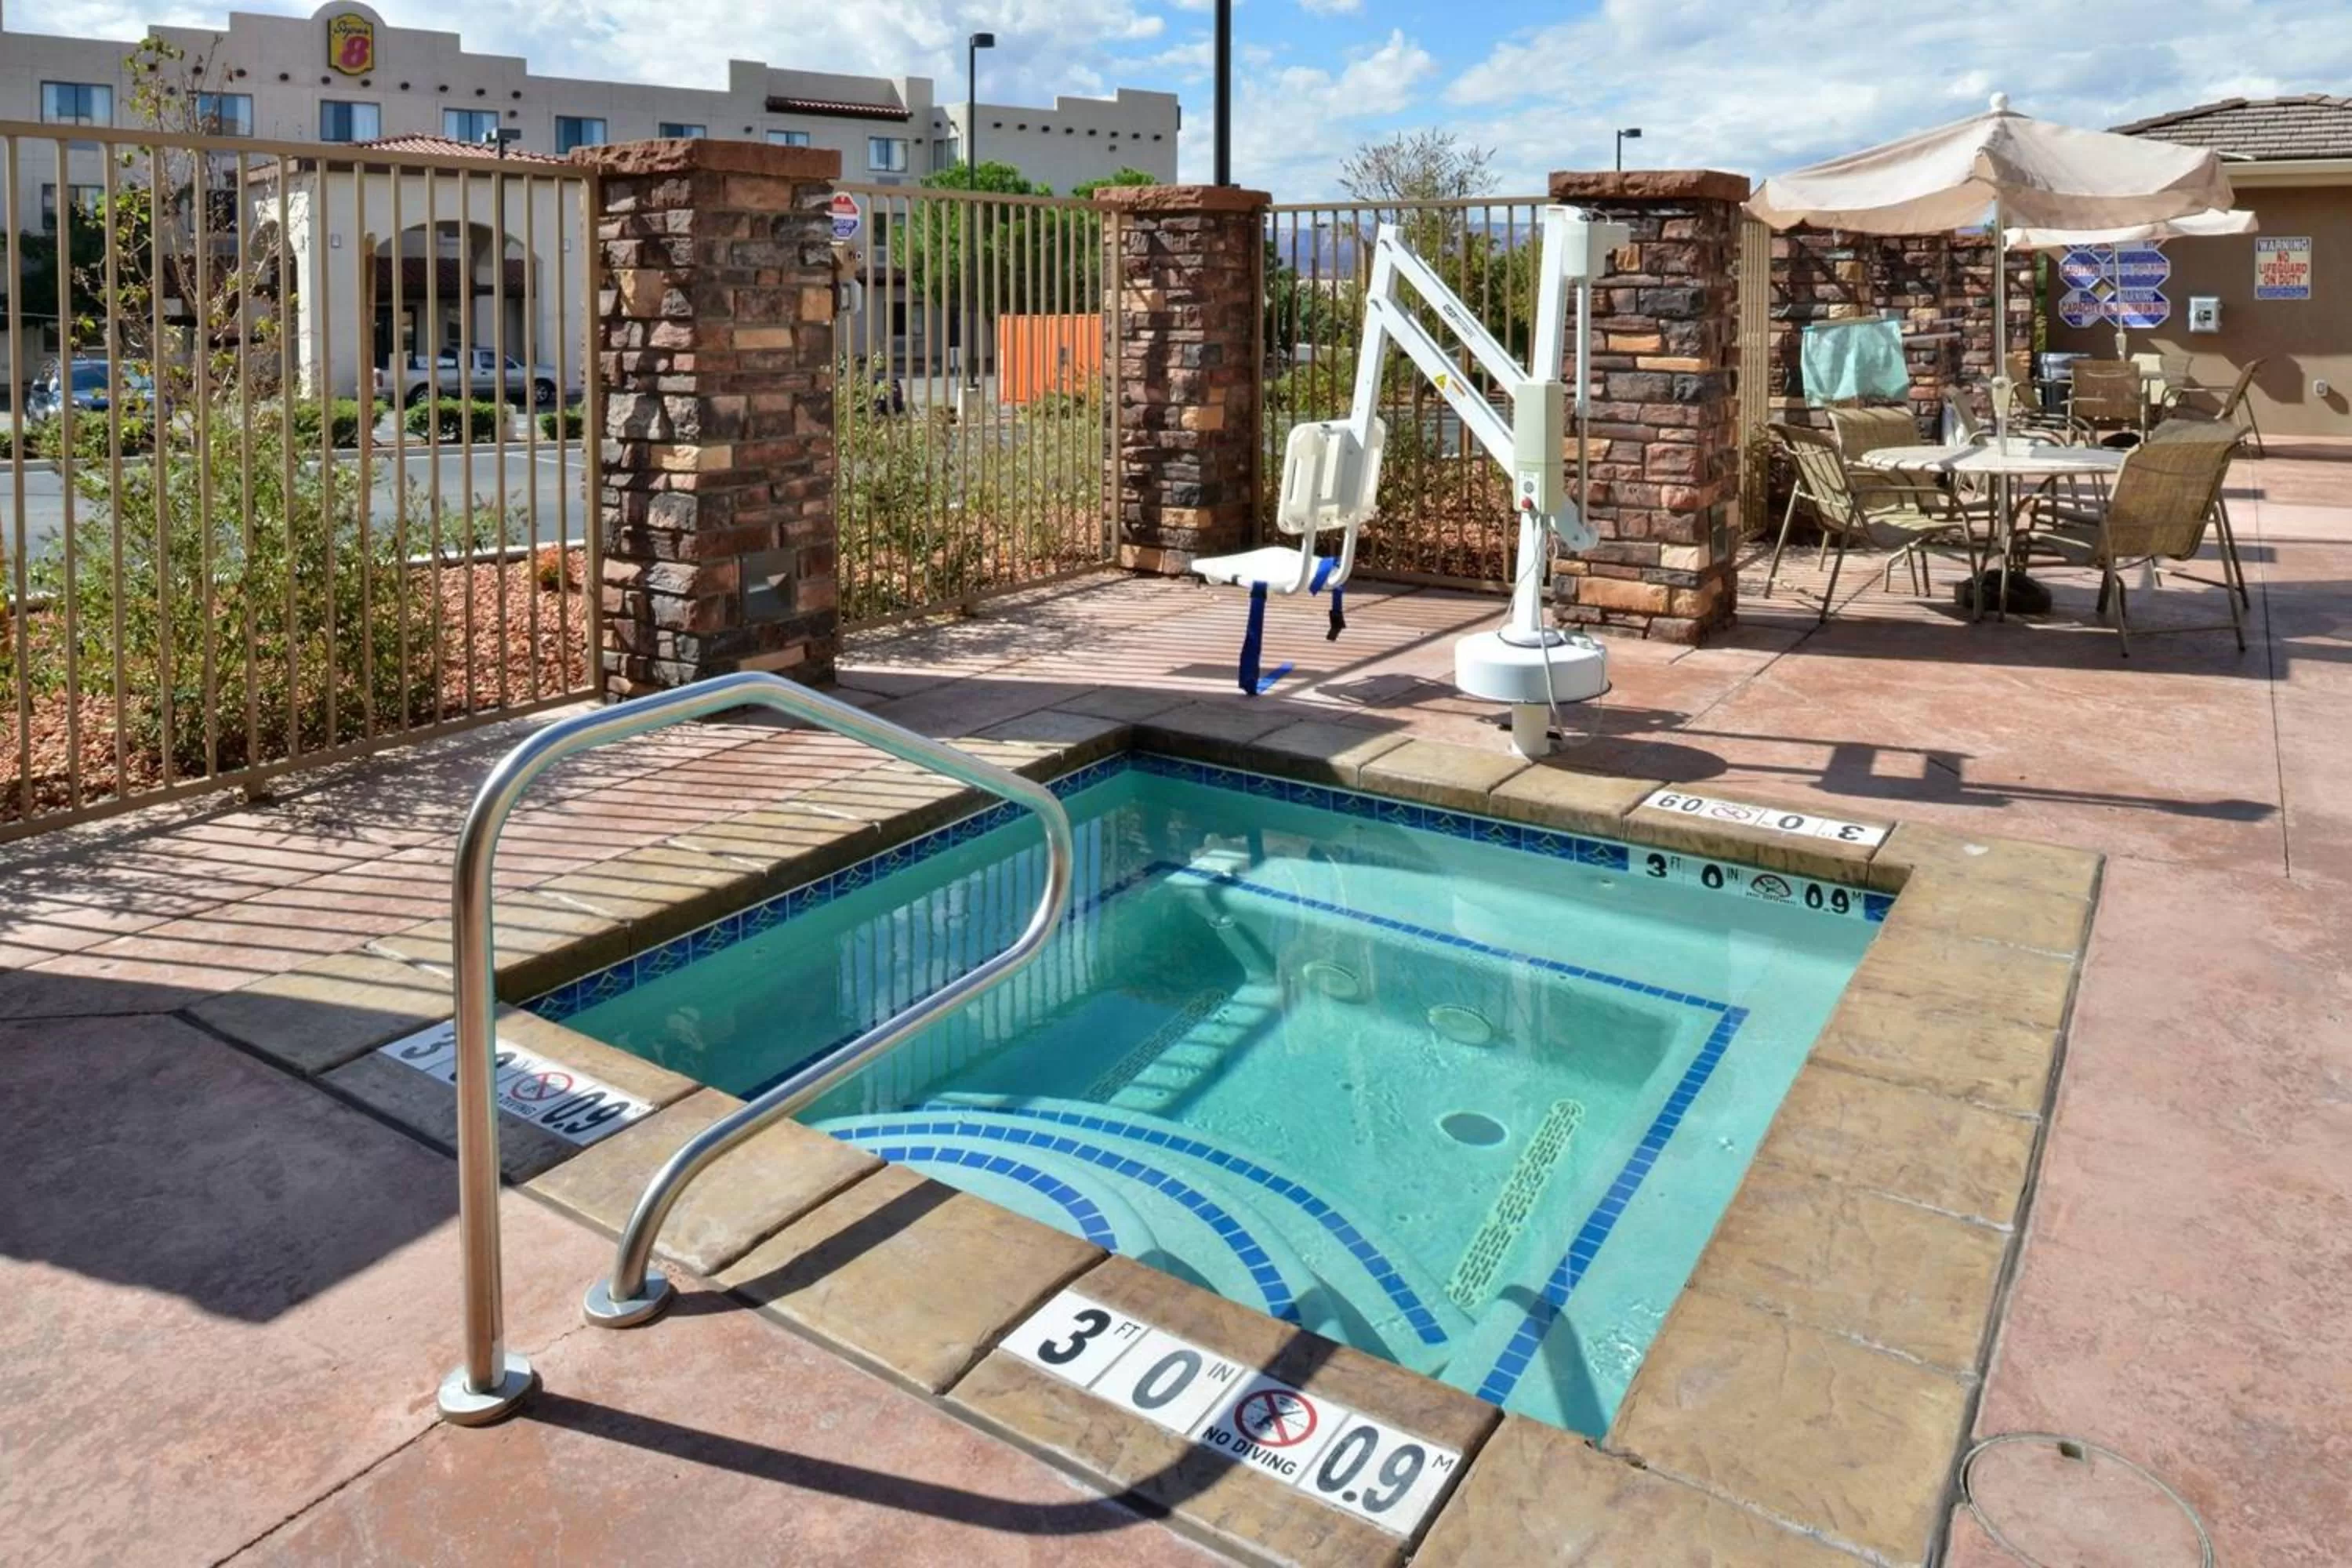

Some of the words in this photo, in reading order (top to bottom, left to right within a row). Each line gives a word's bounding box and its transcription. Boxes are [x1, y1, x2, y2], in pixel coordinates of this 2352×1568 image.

[341, 35, 369, 68] 8
[2259, 240, 2308, 251] WARNING
[2258, 263, 2307, 274] LIFEGUARD
[1837, 826, 1865, 841] 3
[1645, 853, 1668, 878] 3
[1670, 857, 1682, 869] FT
[1701, 863, 1724, 889] 0
[1726, 868, 1740, 881] IN
[1805, 884, 1850, 914] 0.9
[540, 1091, 630, 1134] 0.9
[1037, 1308, 1112, 1365] 3
[1114, 1322, 1142, 1341] FT
[1131, 1349, 1203, 1410] 0
[1207, 1361, 1233, 1382] IN
[1316, 1425, 1426, 1514] 0.9
[1431, 1454, 1454, 1473] M
[1201, 1425, 1231, 1446] NO
[1232, 1439, 1298, 1475] DIVING
